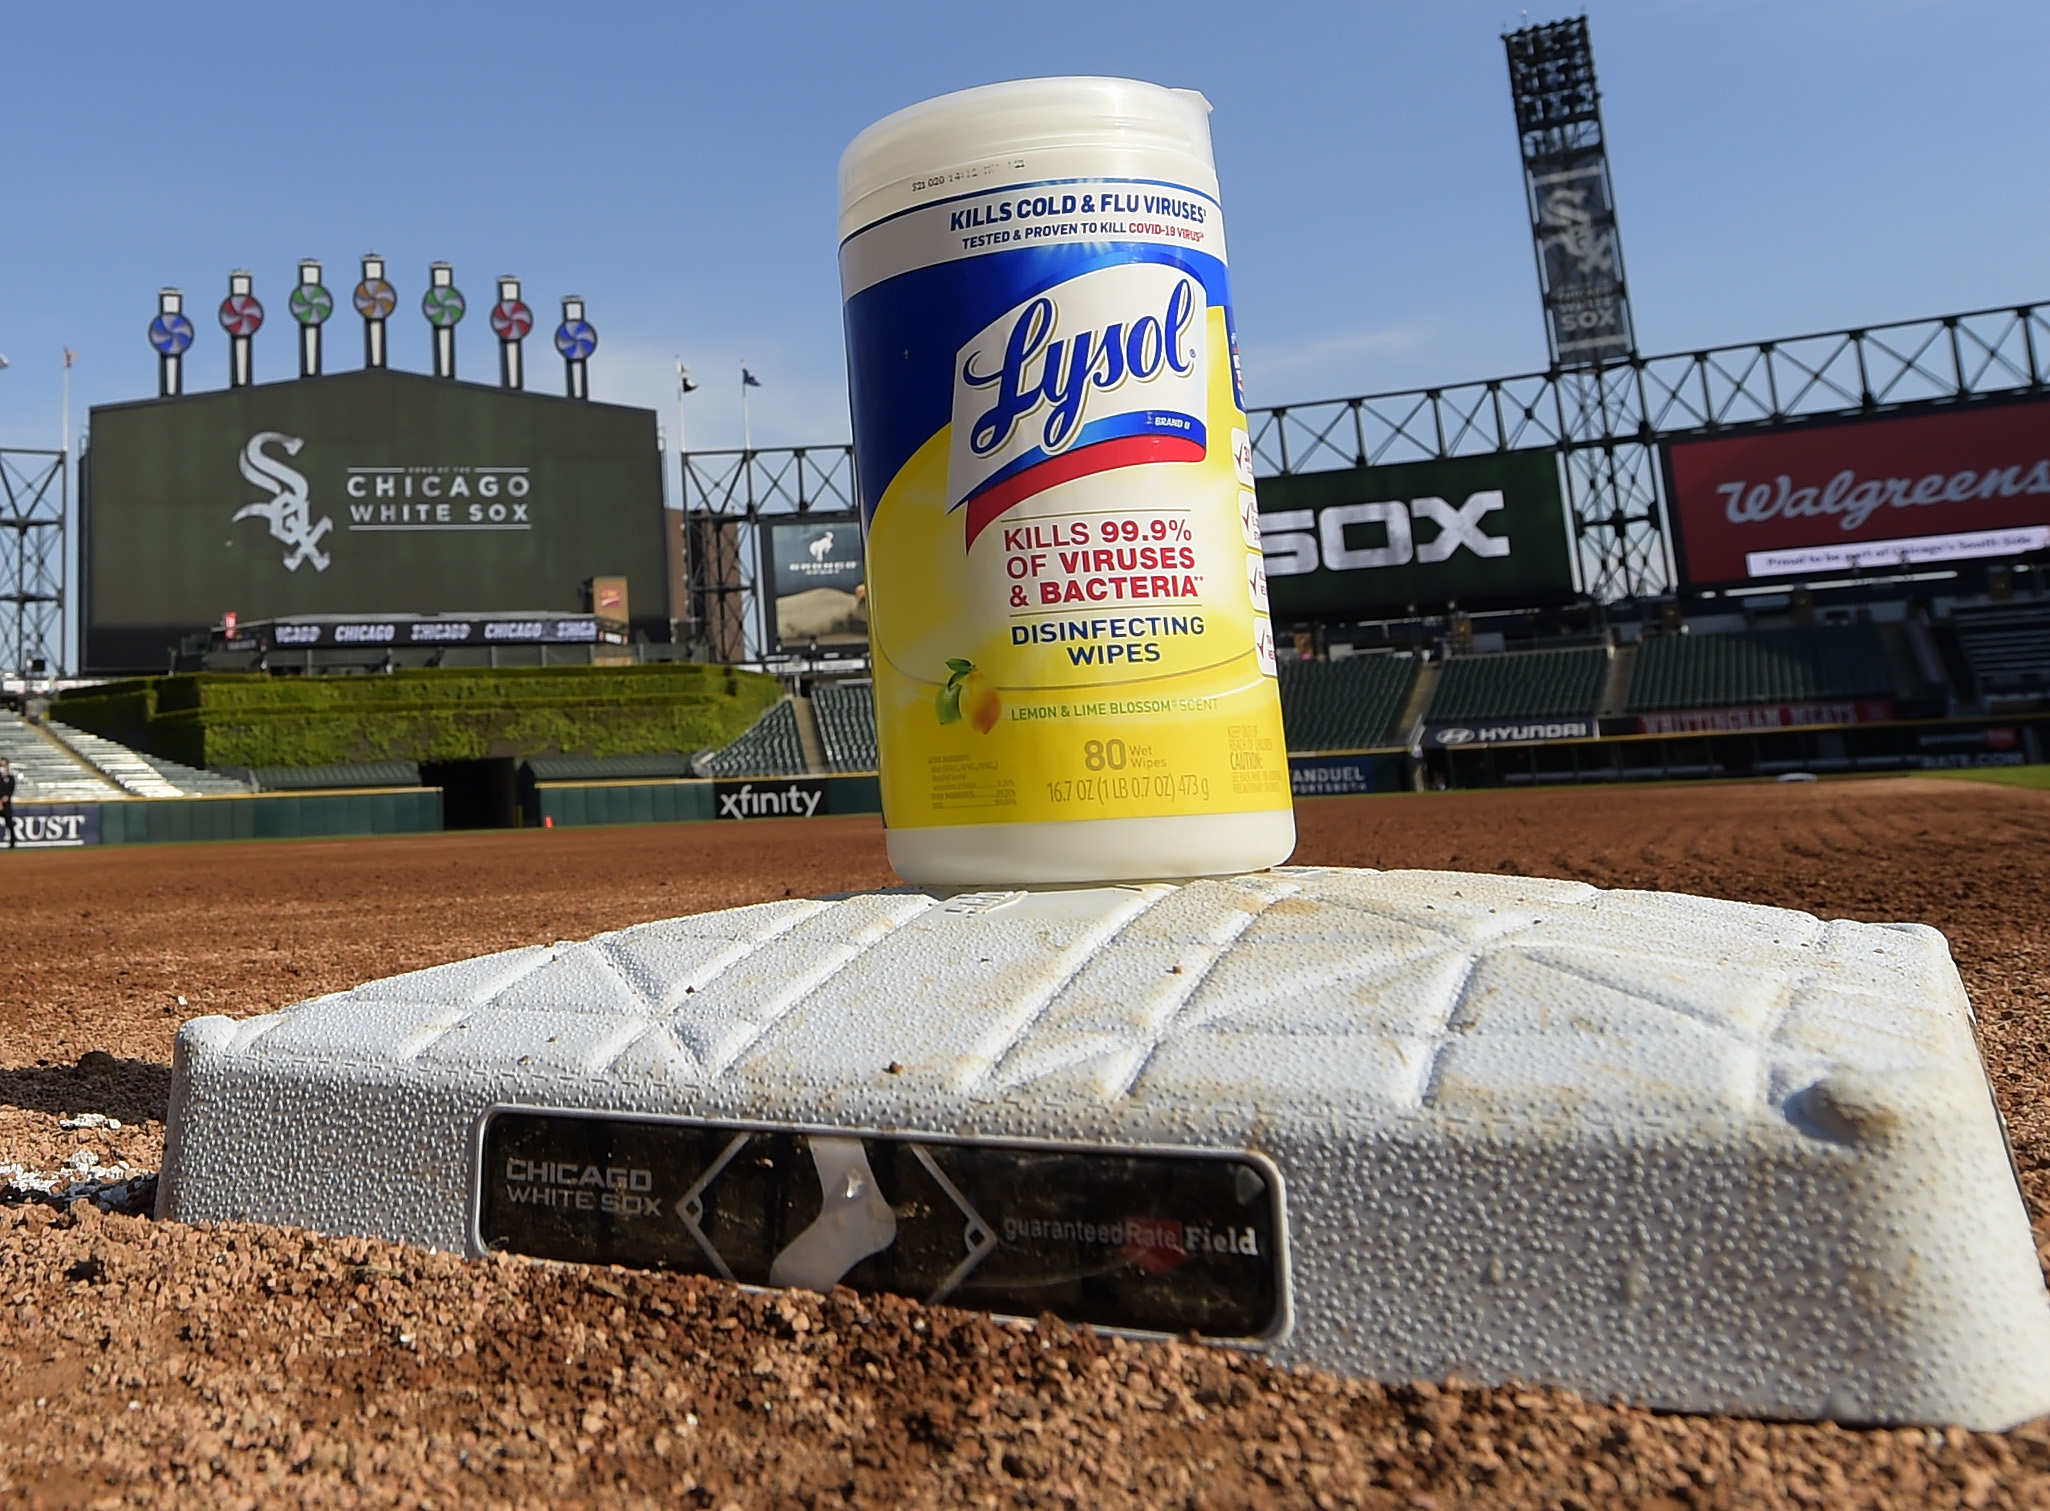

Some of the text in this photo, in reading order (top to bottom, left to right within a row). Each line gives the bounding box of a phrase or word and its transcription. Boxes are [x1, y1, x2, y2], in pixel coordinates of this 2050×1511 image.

[950, 202, 1012, 231] KILLS
[1017, 195, 1077, 218] COLD
[1081, 196, 1096, 213] &
[1100, 193, 1139, 213] FLU
[962, 230, 1011, 249] TESTED
[1012, 229, 1022, 241] &
[1025, 223, 1078, 240] PROVEN
[1081, 222, 1098, 234] TO
[1100, 222, 1127, 234] KILL
[1128, 222, 1176, 237] COVID-19
[962, 278, 1193, 454] Lysol
[347, 475, 530, 498] CHICAGO
[1716, 459, 2050, 530] Walgreens
[349, 503, 529, 523] WHITE SOX
[1003, 519, 1192, 551] KILLS 99.9%
[1259, 489, 1511, 578] SOX
[1006, 547, 1195, 579] OF VIRUSES
[1009, 584, 1029, 608] &
[1011, 616, 1205, 645] DISINFECTING
[1067, 643, 1161, 666] WIPES
[1011, 706, 1057, 721] LEMON
[1060, 706, 1070, 717] &
[1074, 703, 1107, 717] LIME
[1179, 698, 1218, 712] SCENT
[1479, 722, 1588, 742] HYUNDAI
[1084, 738, 1153, 771] 80 Wet
[1130, 757, 1167, 770] Wipes
[1047, 780, 1072, 802] 16.7
[1076, 779, 1094, 801] OZ
[1097, 776, 1109, 805] (1
[1112, 778, 1129, 799] LB
[1132, 776, 1150, 797] 0.7
[1154, 773, 1175, 802] OZ)
[1179, 774, 1198, 796] 473
[1201, 777, 1209, 801] g
[1291, 766, 1367, 784] ANDUEL
[719, 784, 823, 820] xfinity
[0, 814, 86, 842] RUST
[506, 1157, 653, 1192] CHICAGO
[506, 1184, 663, 1218] WHITE SOX
[1185, 1221, 1259, 1256] Field
